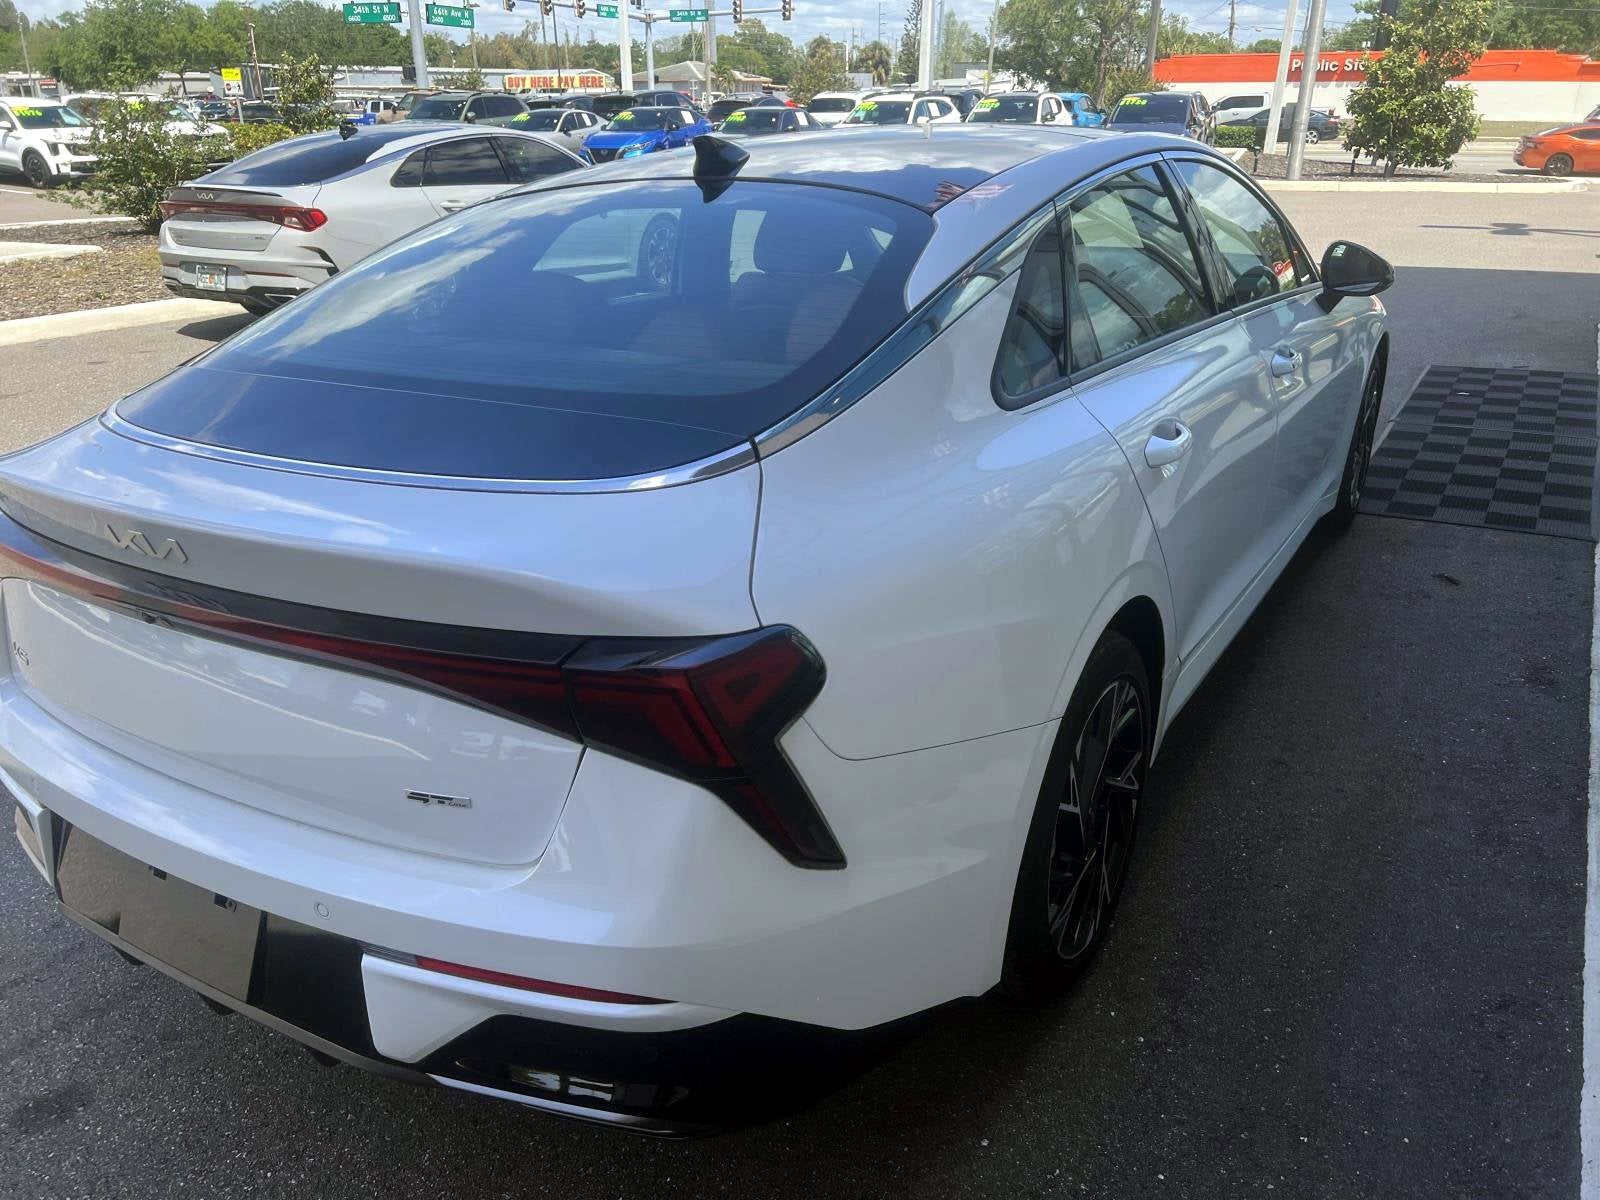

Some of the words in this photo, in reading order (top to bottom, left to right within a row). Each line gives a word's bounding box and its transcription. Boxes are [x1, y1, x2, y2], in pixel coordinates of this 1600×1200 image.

[353, 5, 370, 14] 34th
[372, 5, 381, 14] St
[383, 5, 389, 14] N
[433, 7, 448, 16] 66th
[451, 10, 461, 18] Ave
[464, 10, 469, 19] N
[1291, 58, 1339, 72] Plic
[507, 76, 527, 88] BUY
[530, 76, 554, 88] HERE
[558, 76, 576, 88] PAY
[580, 76, 604, 88] HERE
[196, 192, 214, 200] KIA
[104, 524, 189, 564] KIA
